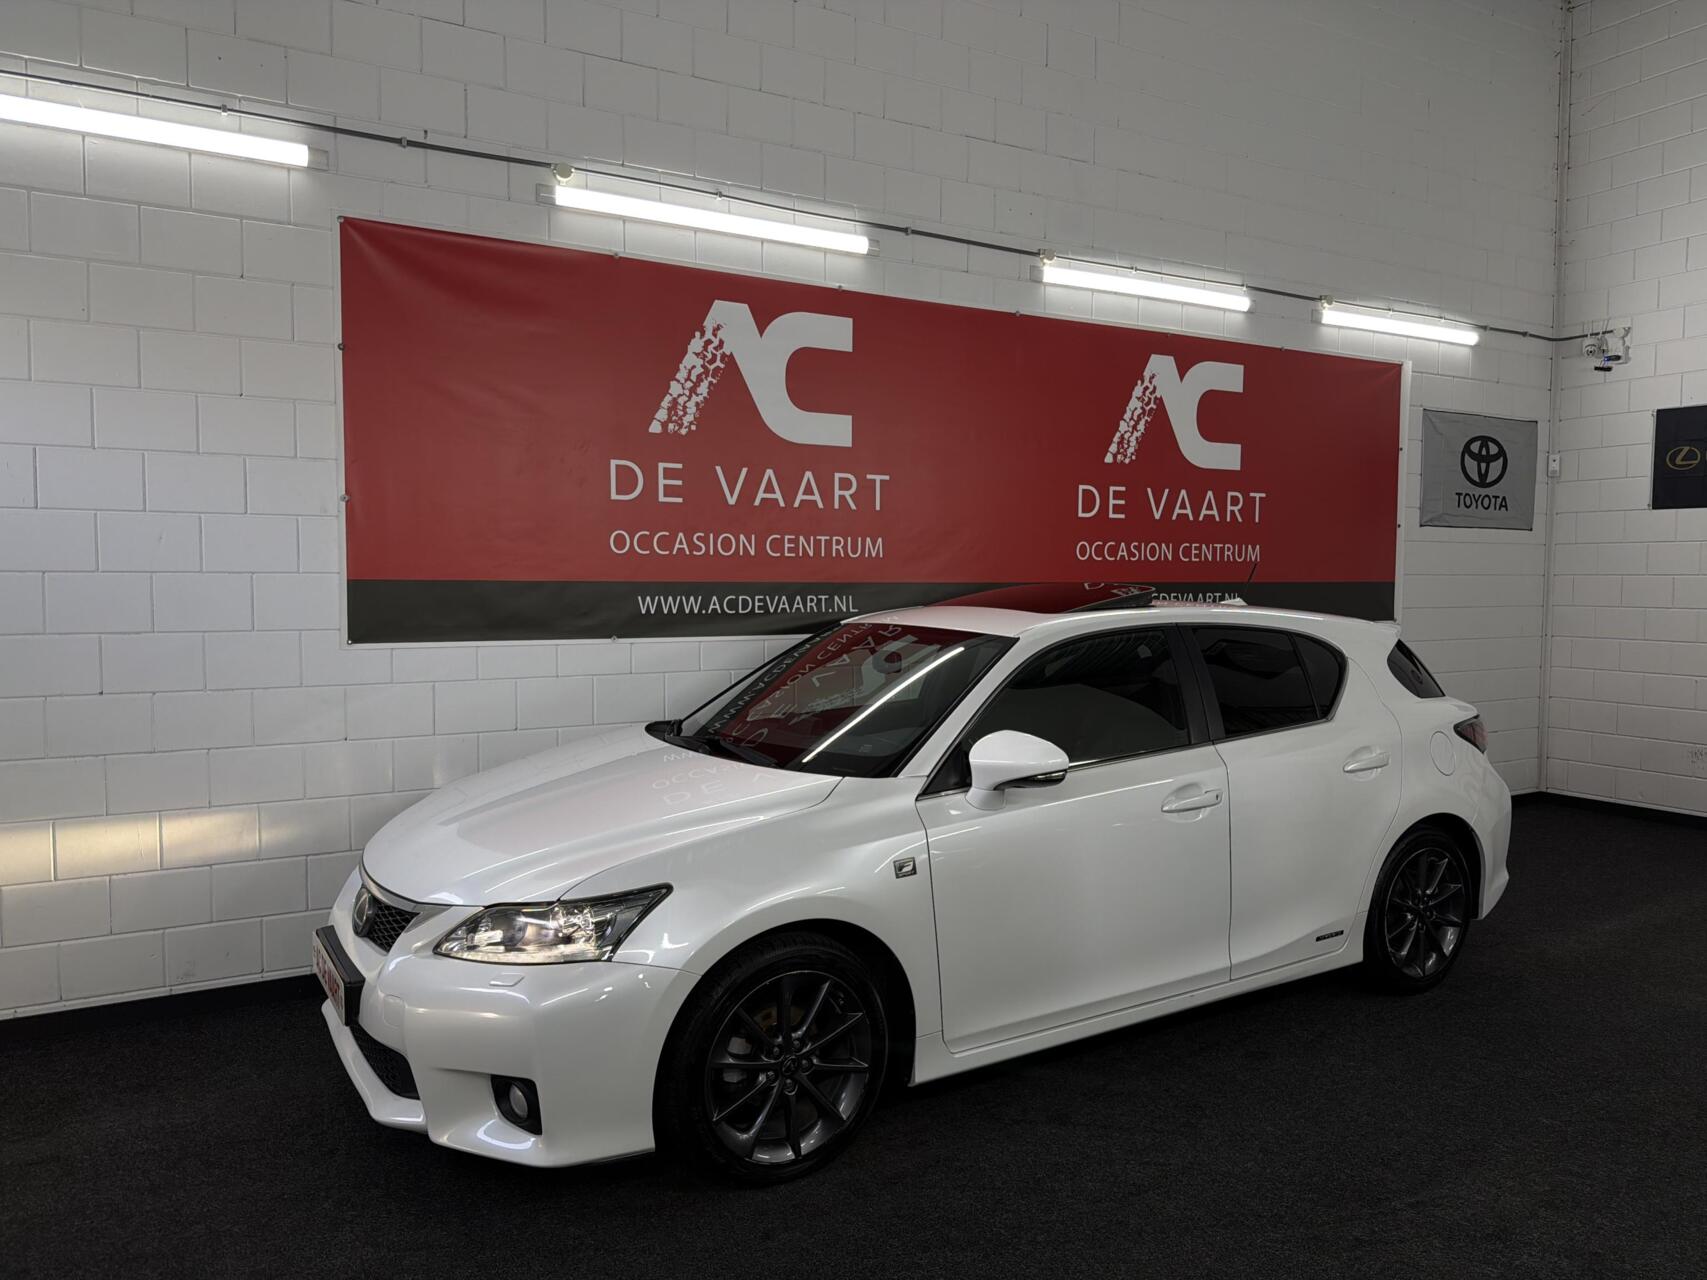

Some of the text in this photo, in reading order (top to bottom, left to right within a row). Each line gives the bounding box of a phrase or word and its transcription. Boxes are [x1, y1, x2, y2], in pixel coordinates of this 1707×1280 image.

[649, 300, 854, 449] AC
[1105, 354, 1245, 471] AC
[610, 459, 890, 512] DE VAART
[1456, 492, 1509, 513] TOYOTA
[1077, 484, 1266, 524] DE VAART
[609, 529, 884, 559] OCCASION CENTRUM
[1075, 540, 1261, 563] OCCASION CENTRUM
[637, 595, 858, 615] WWW.ACDEVAART.NL
